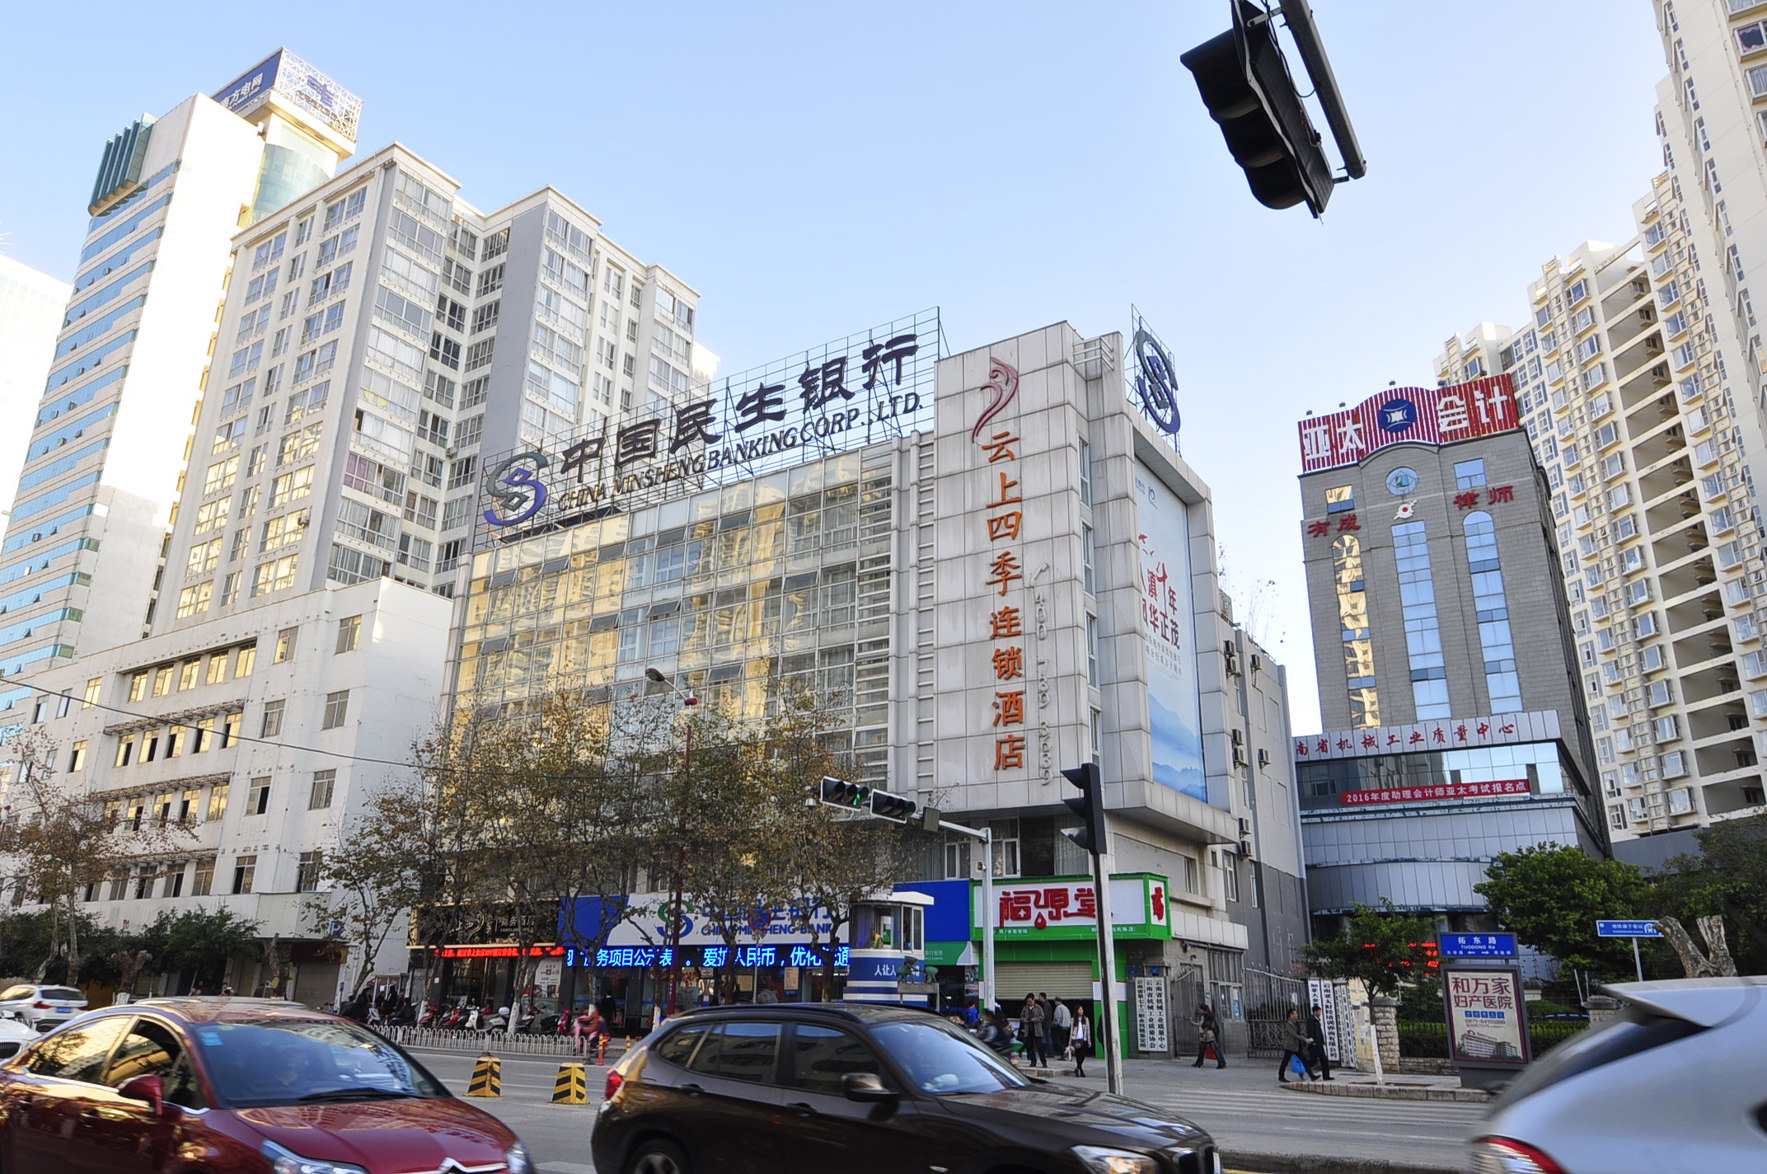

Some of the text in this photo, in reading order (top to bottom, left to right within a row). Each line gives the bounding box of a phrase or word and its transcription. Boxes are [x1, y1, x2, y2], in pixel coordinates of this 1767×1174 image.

[559, 334, 919, 484] 中国民生银行
[1303, 385, 1508, 460] 亚太 会计
[558, 483, 608, 511] CHINA
[613, 454, 706, 496] MINSHENG
[707, 426, 798, 470] BANKING
[877, 392, 923, 421] LTD.
[1307, 485, 1515, 538] 有成 律师
[981, 430, 1026, 771] 云上四季连锁酒店
[701, 922, 735, 936] CHIA
[739, 922, 797, 935] MIHENG
[1457, 936, 1497, 945] 拓东路
[1451, 977, 1511, 995] 和万家
[1454, 994, 1513, 1009] 妇产医院
